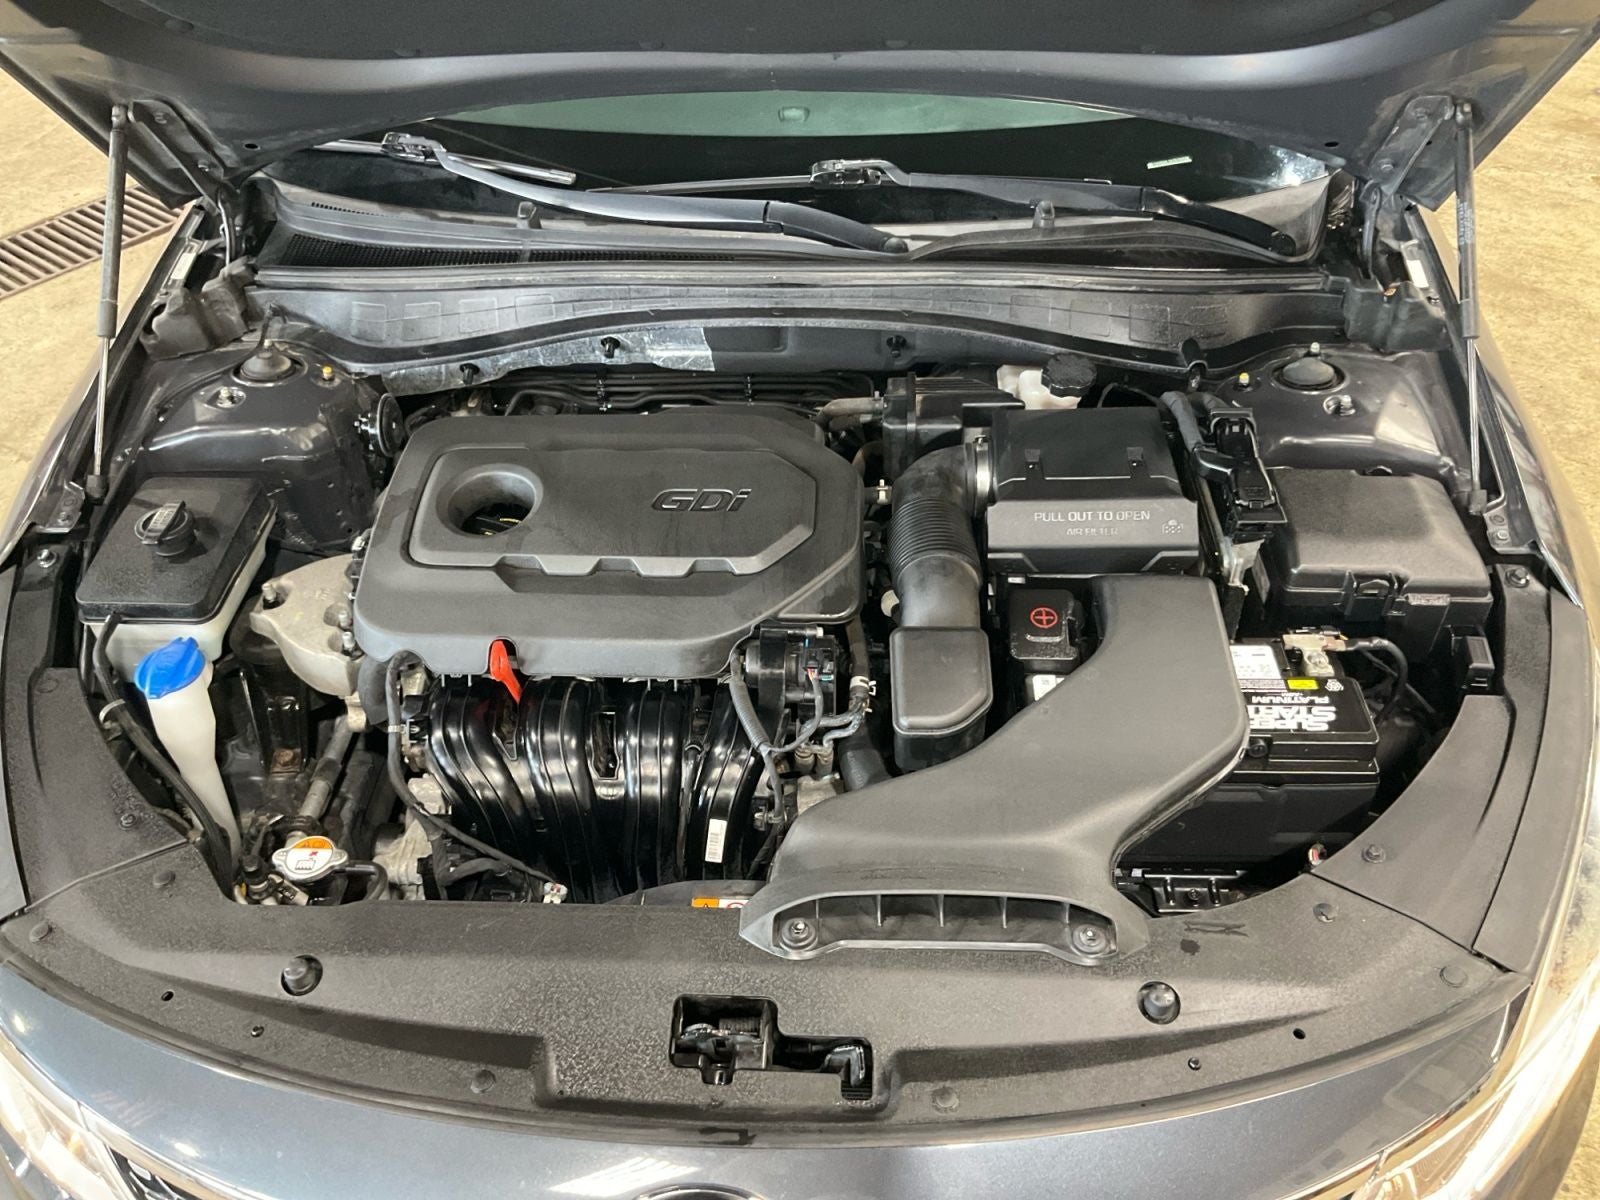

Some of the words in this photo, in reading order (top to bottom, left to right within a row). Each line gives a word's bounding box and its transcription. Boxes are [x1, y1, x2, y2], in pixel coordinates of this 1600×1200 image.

[651, 488, 752, 512] GDi
[1034, 511, 1065, 522] PULL
[1068, 511, 1093, 522] OUT
[1097, 511, 1113, 521] TO
[1116, 510, 1151, 521] OPEN
[1066, 527, 1083, 536] AIR
[1251, 695, 1330, 704] PLATINUM
